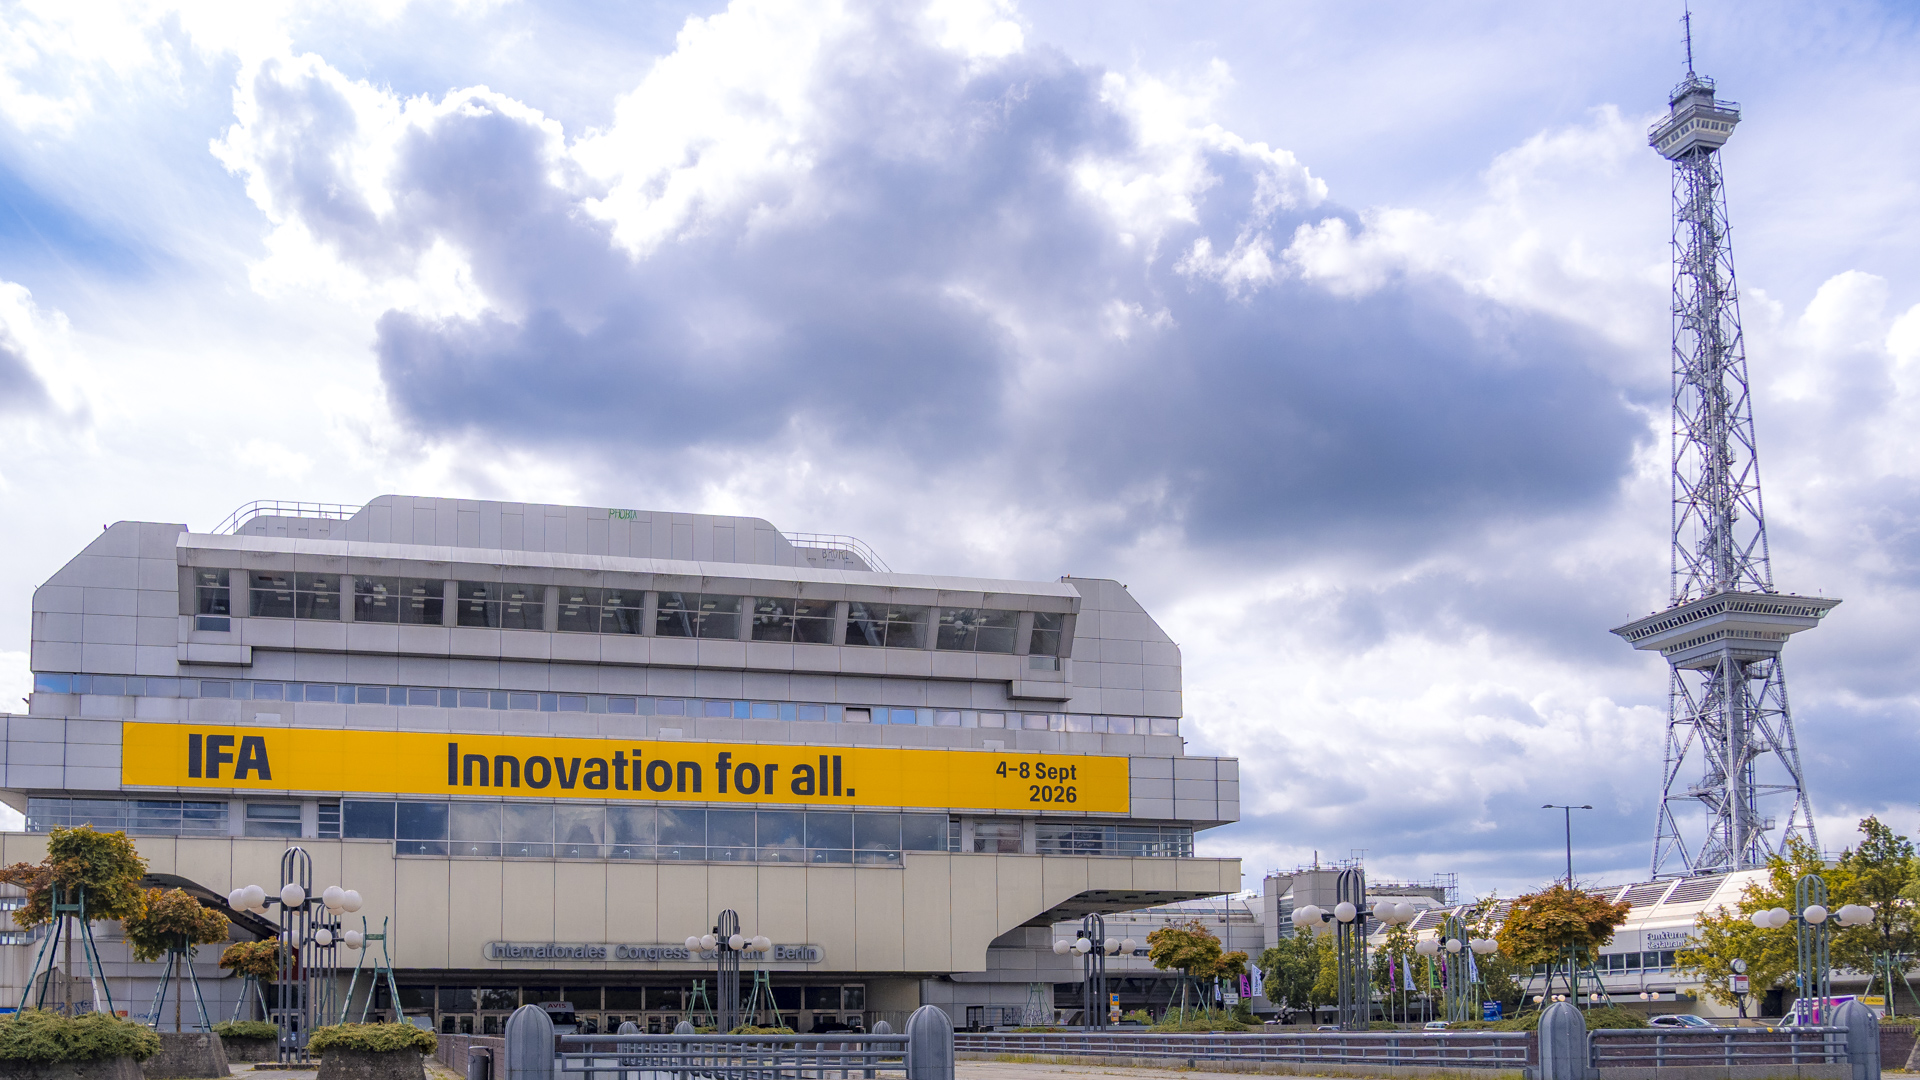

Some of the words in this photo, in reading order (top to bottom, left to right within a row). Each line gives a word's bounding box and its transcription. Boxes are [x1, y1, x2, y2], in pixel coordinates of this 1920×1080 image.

[188, 733, 272, 781] IFA
[447, 742, 702, 794] Innovation
[716, 751, 778, 796] for
[790, 755, 857, 797] all.
[1034, 762, 1077, 784] Sept
[1029, 784, 1077, 804] 2026
[491, 943, 607, 959] Internationales
[615, 944, 691, 962] Congress
[700, 947, 765, 960] Ceum
[774, 945, 817, 960] Berlin
